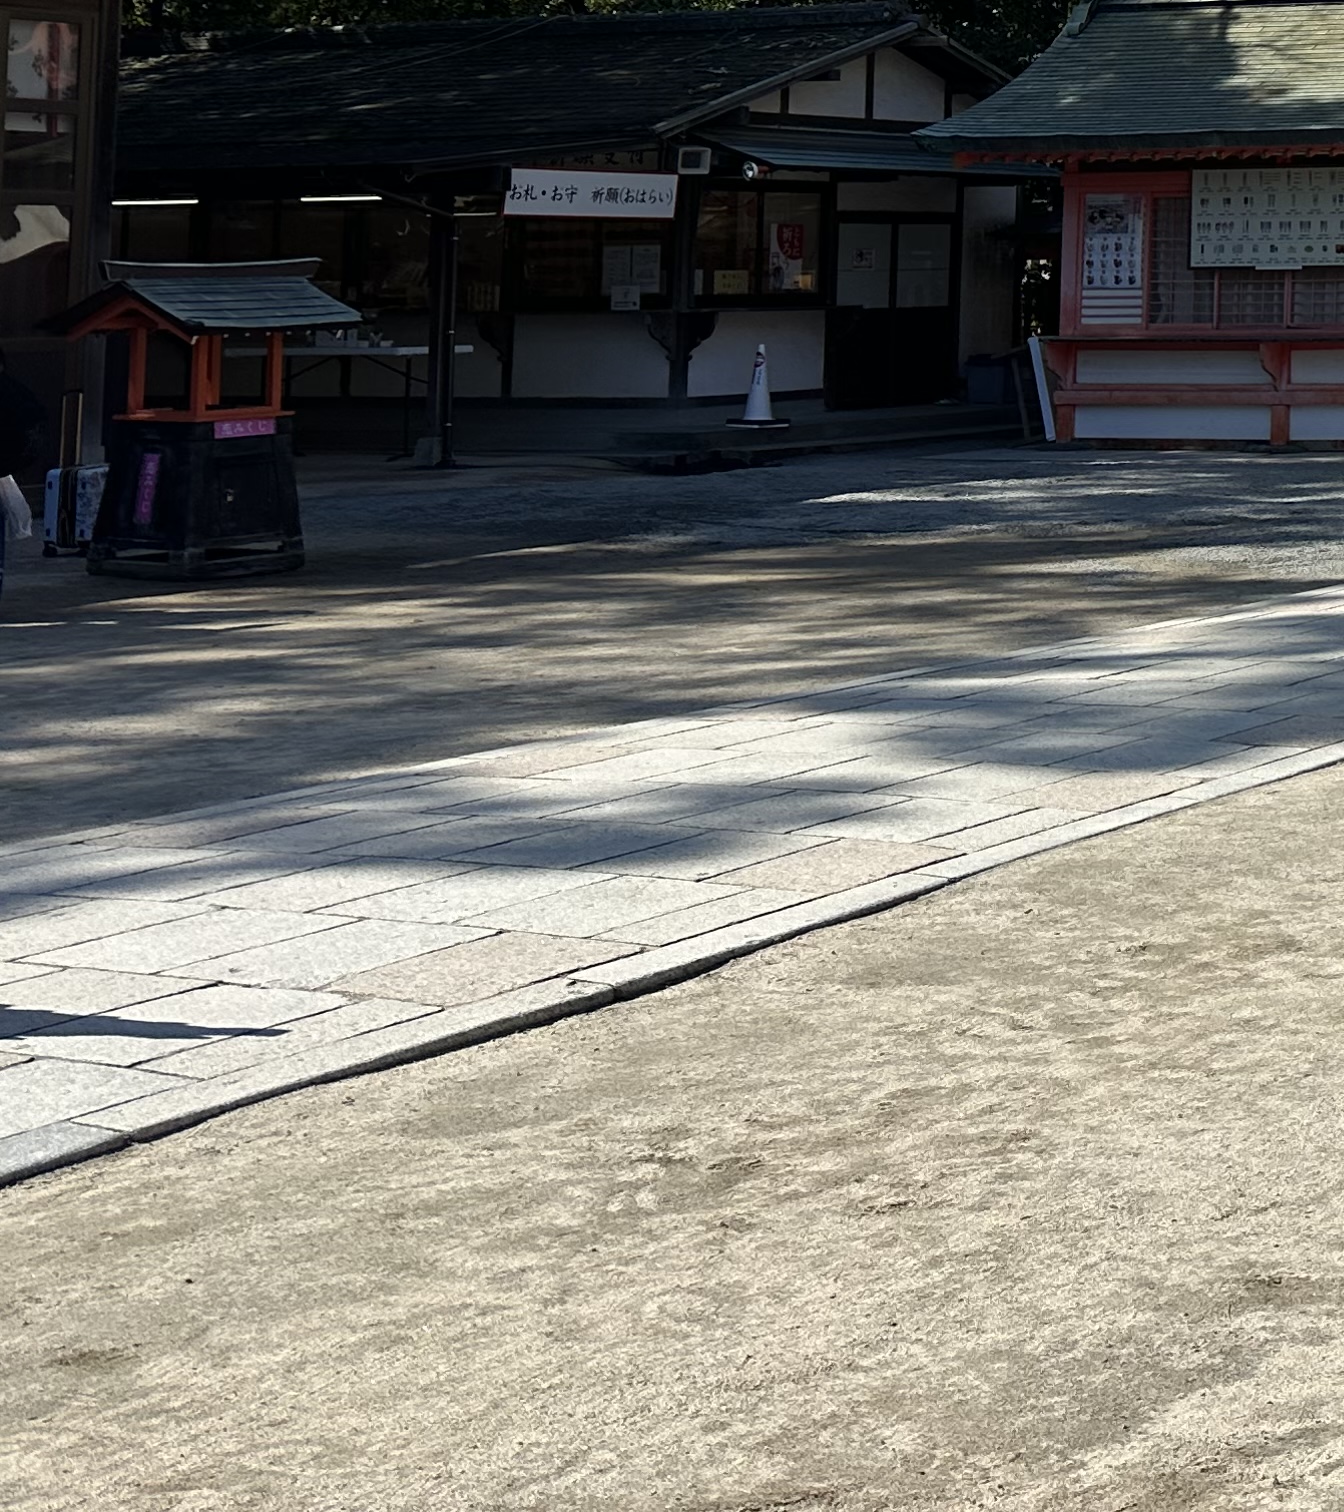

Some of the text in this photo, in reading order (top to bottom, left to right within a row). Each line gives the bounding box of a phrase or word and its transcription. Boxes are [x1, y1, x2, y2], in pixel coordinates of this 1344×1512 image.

[509, 183, 673, 205] お札・お守 祈願(おはらい)
